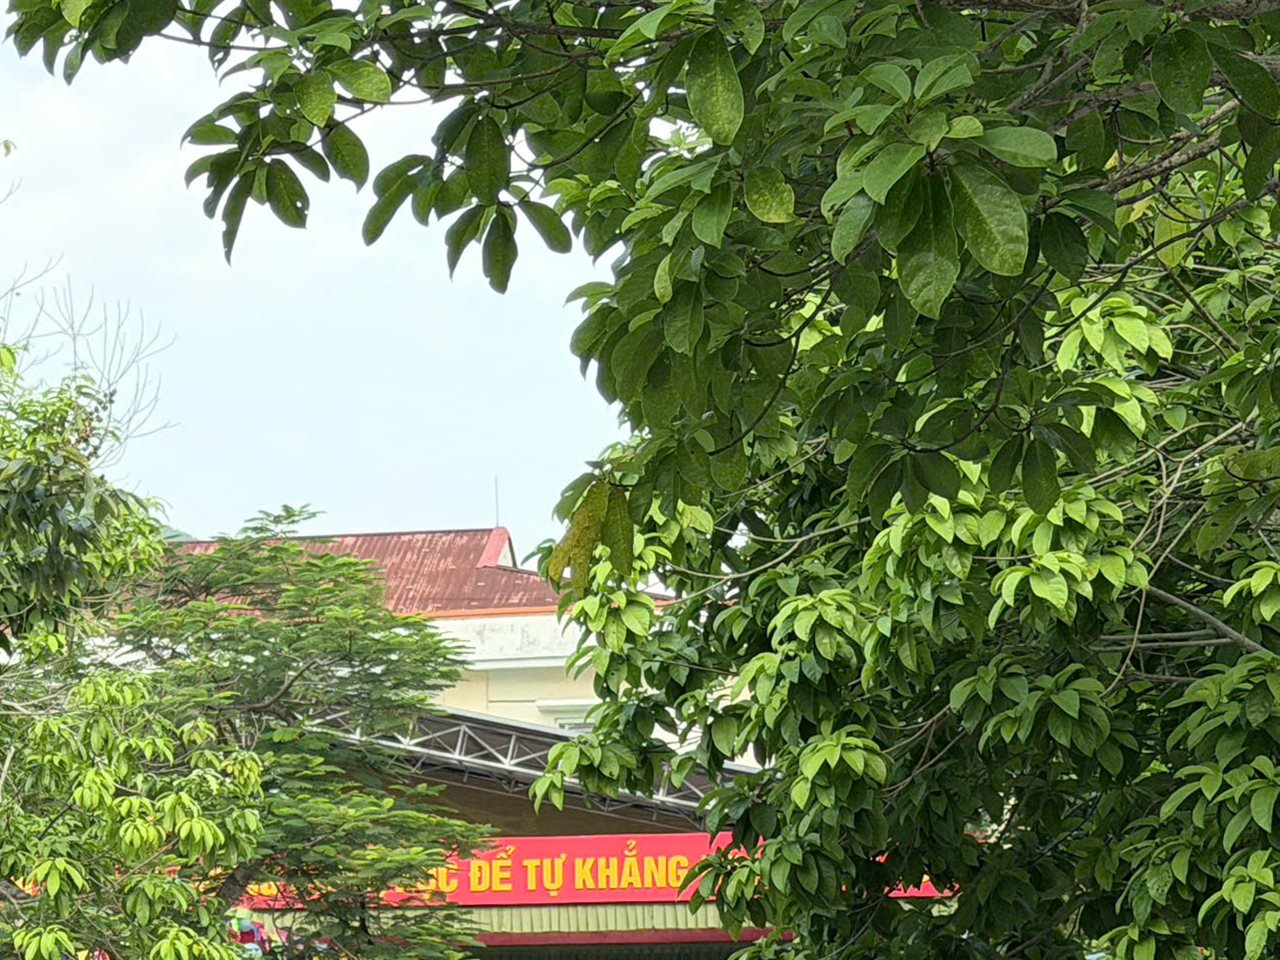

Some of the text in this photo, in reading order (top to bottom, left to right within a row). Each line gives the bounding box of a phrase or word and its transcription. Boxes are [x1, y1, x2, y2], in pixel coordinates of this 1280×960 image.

[469, 846, 515, 892] ĐỂ
[522, 854, 567, 896] TỰ
[575, 840, 689, 890] KHẲNG
